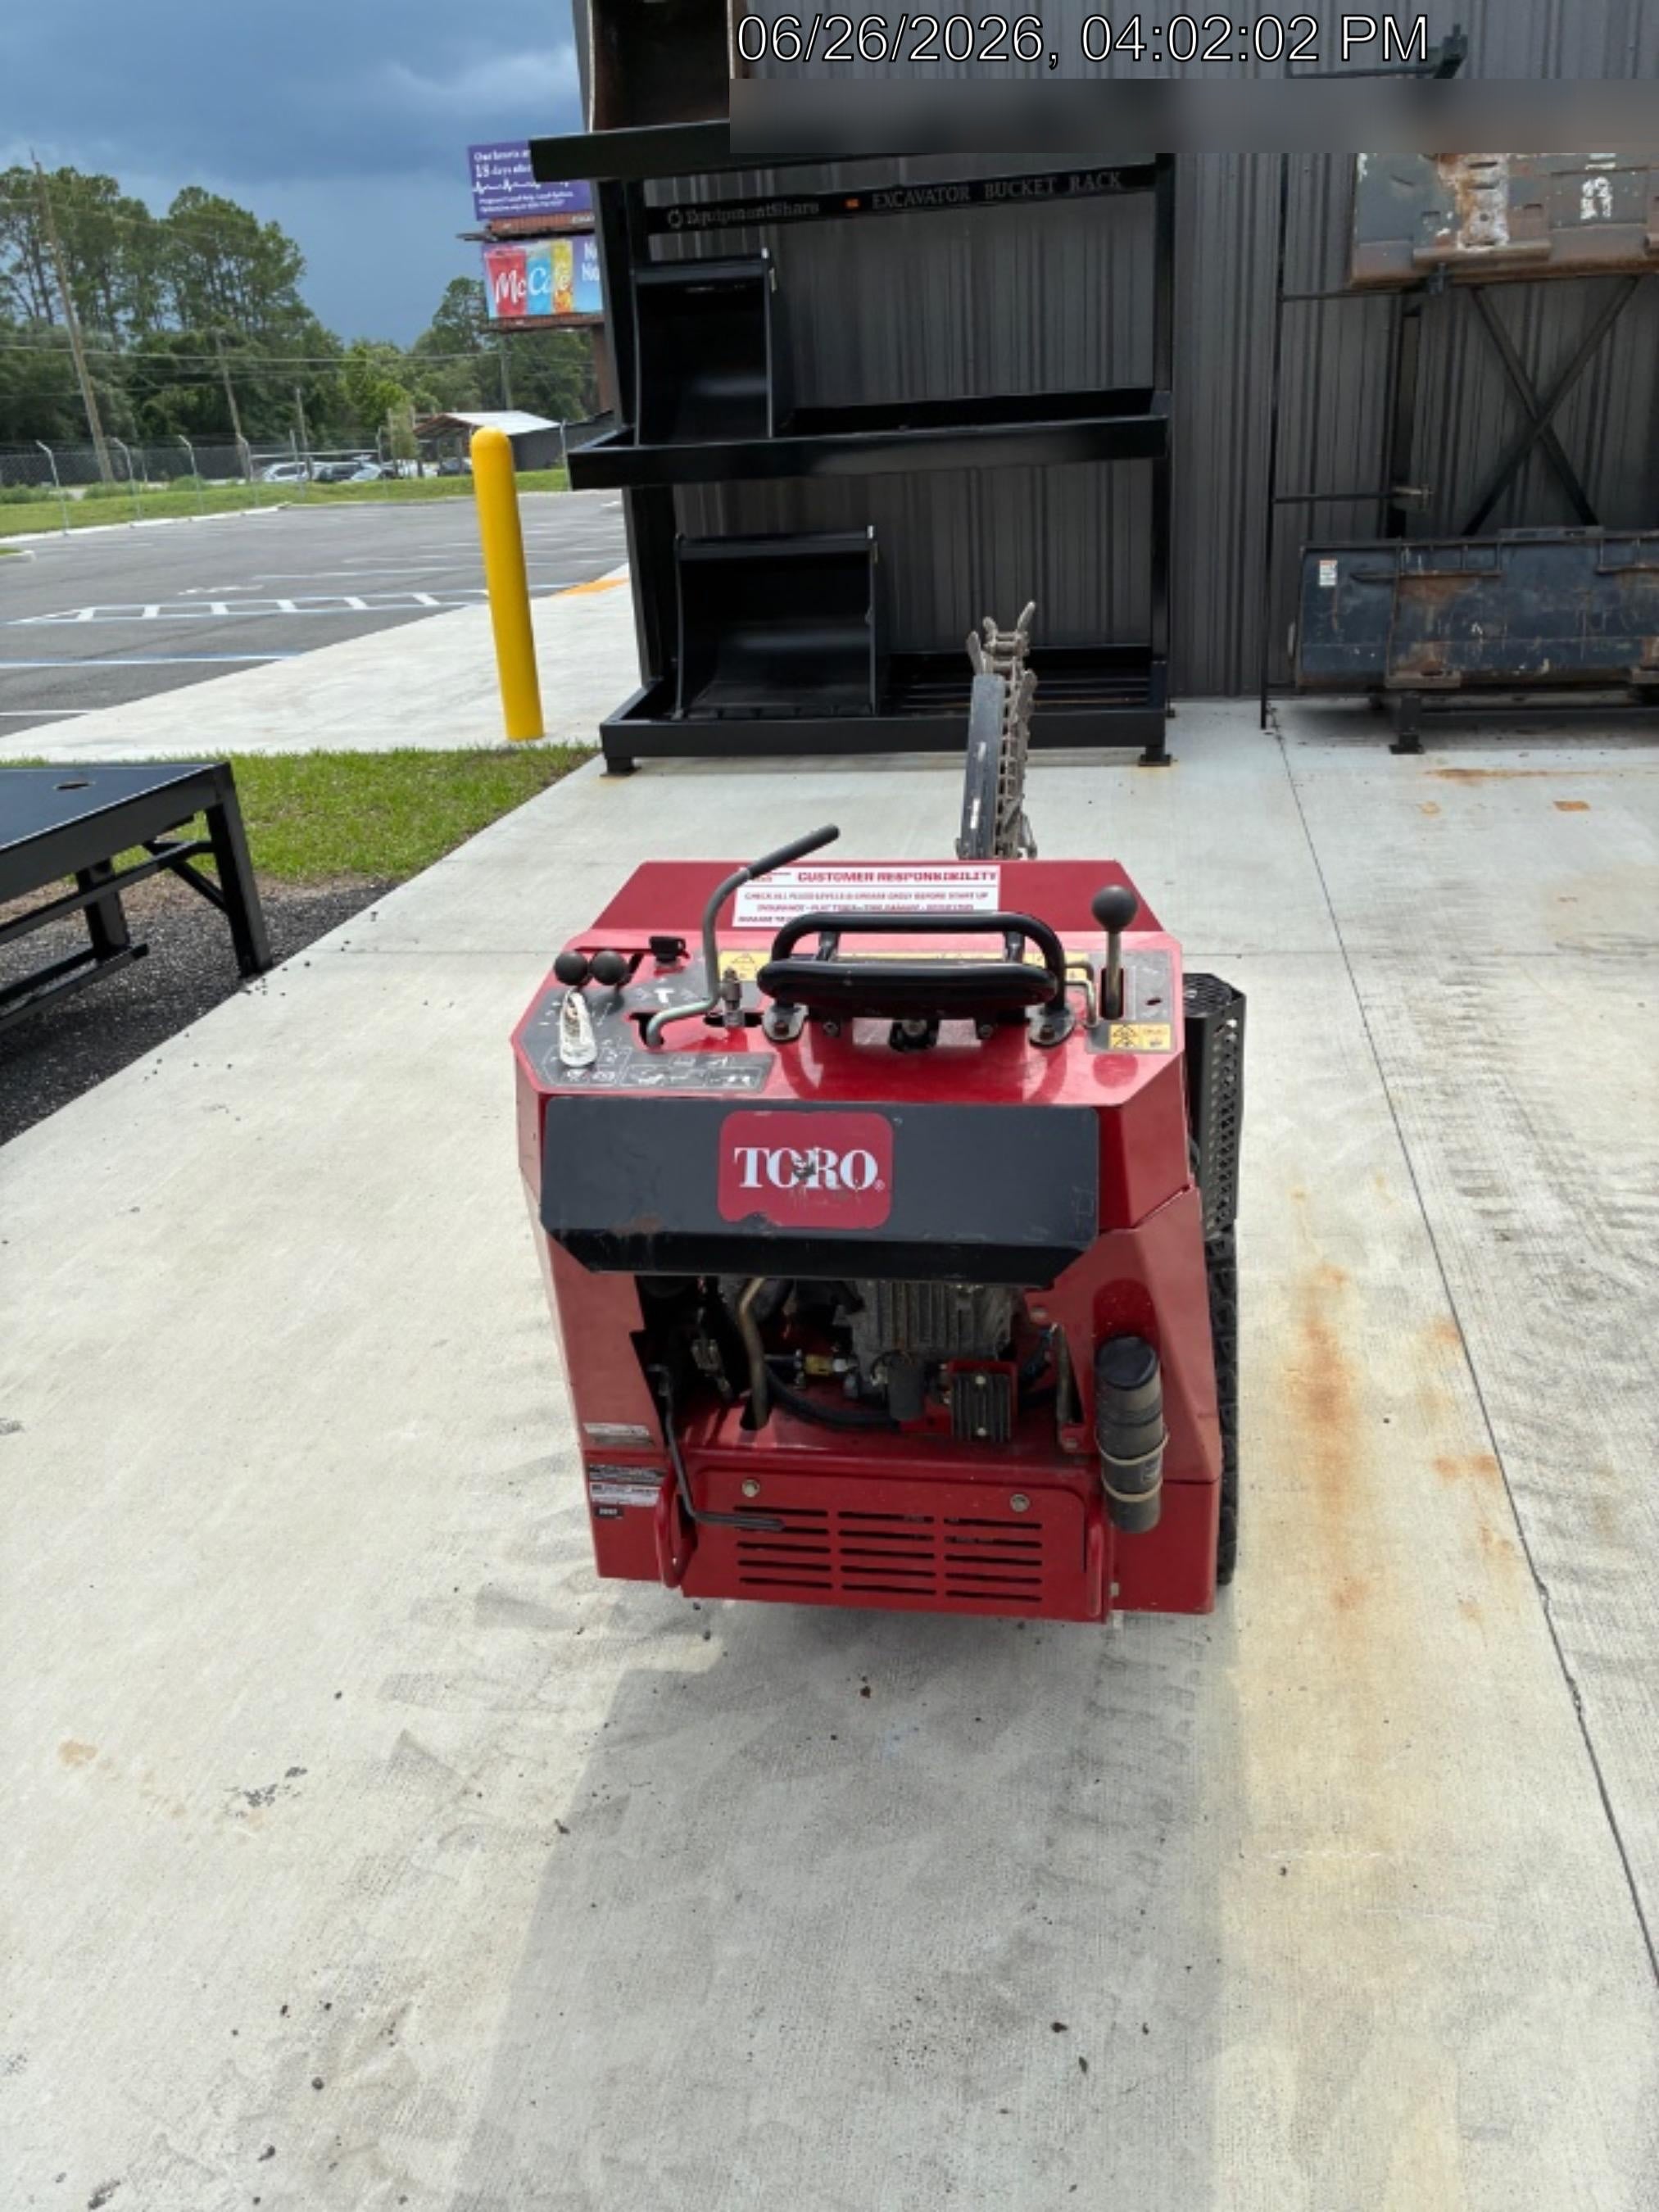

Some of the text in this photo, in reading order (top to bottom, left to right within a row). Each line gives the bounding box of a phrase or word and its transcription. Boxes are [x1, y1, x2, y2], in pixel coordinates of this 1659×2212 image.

[685, 170, 1122, 227] EquipmentShare EXCAVATOR BUCKET RACK
[798, 871, 996, 882] CUSTOMER RESPONSIBILITY
[815, 891, 844, 900] LEVELS
[914, 891, 945, 900] BEFORE
[949, 891, 973, 900] START
[976, 891, 989, 899] UP
[734, 1146, 879, 1190] TORO
